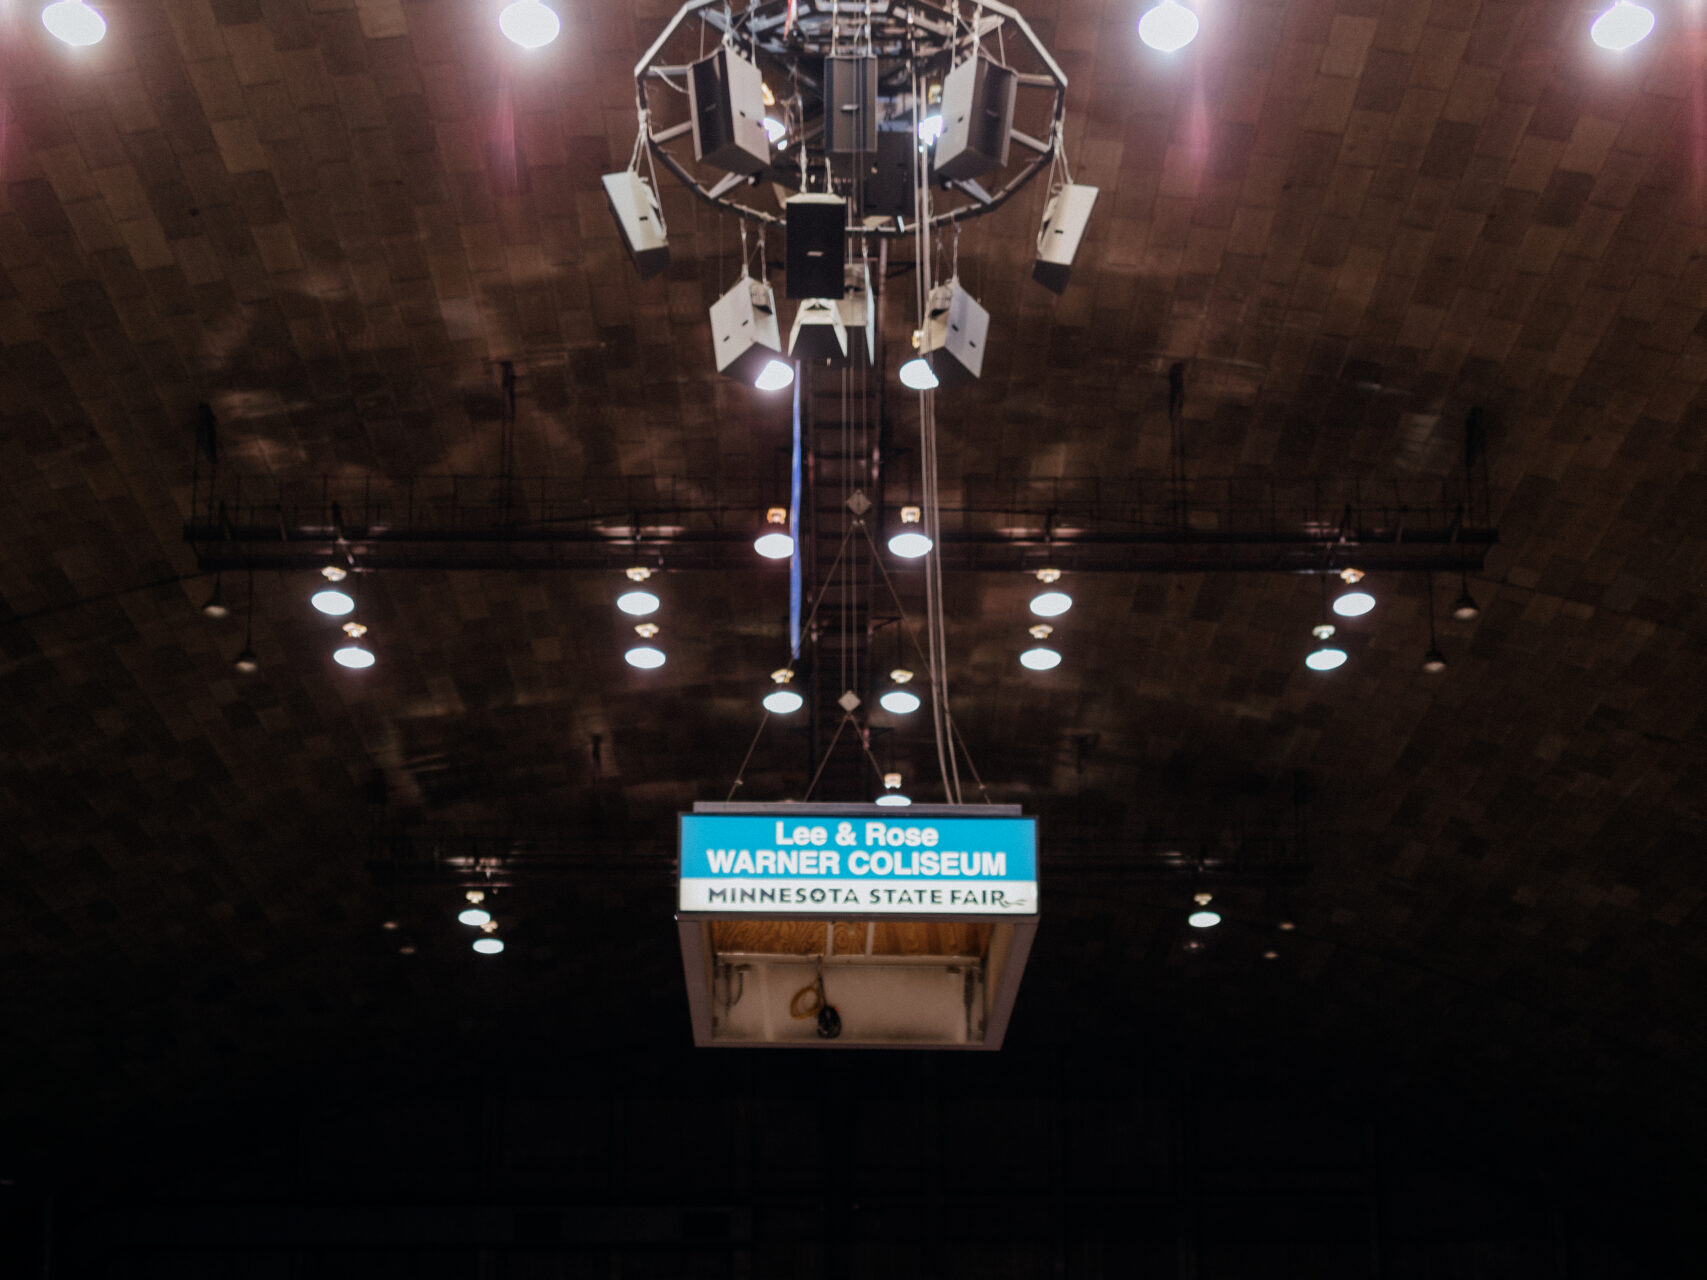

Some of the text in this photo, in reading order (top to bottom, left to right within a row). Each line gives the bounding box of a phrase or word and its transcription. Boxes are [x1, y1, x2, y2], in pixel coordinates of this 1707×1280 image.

[775, 821, 939, 847] Lee & Rose
[706, 849, 1007, 876] WARNER COLISEUM
[708, 887, 1014, 908] MINNESOTA STATE FAIR
